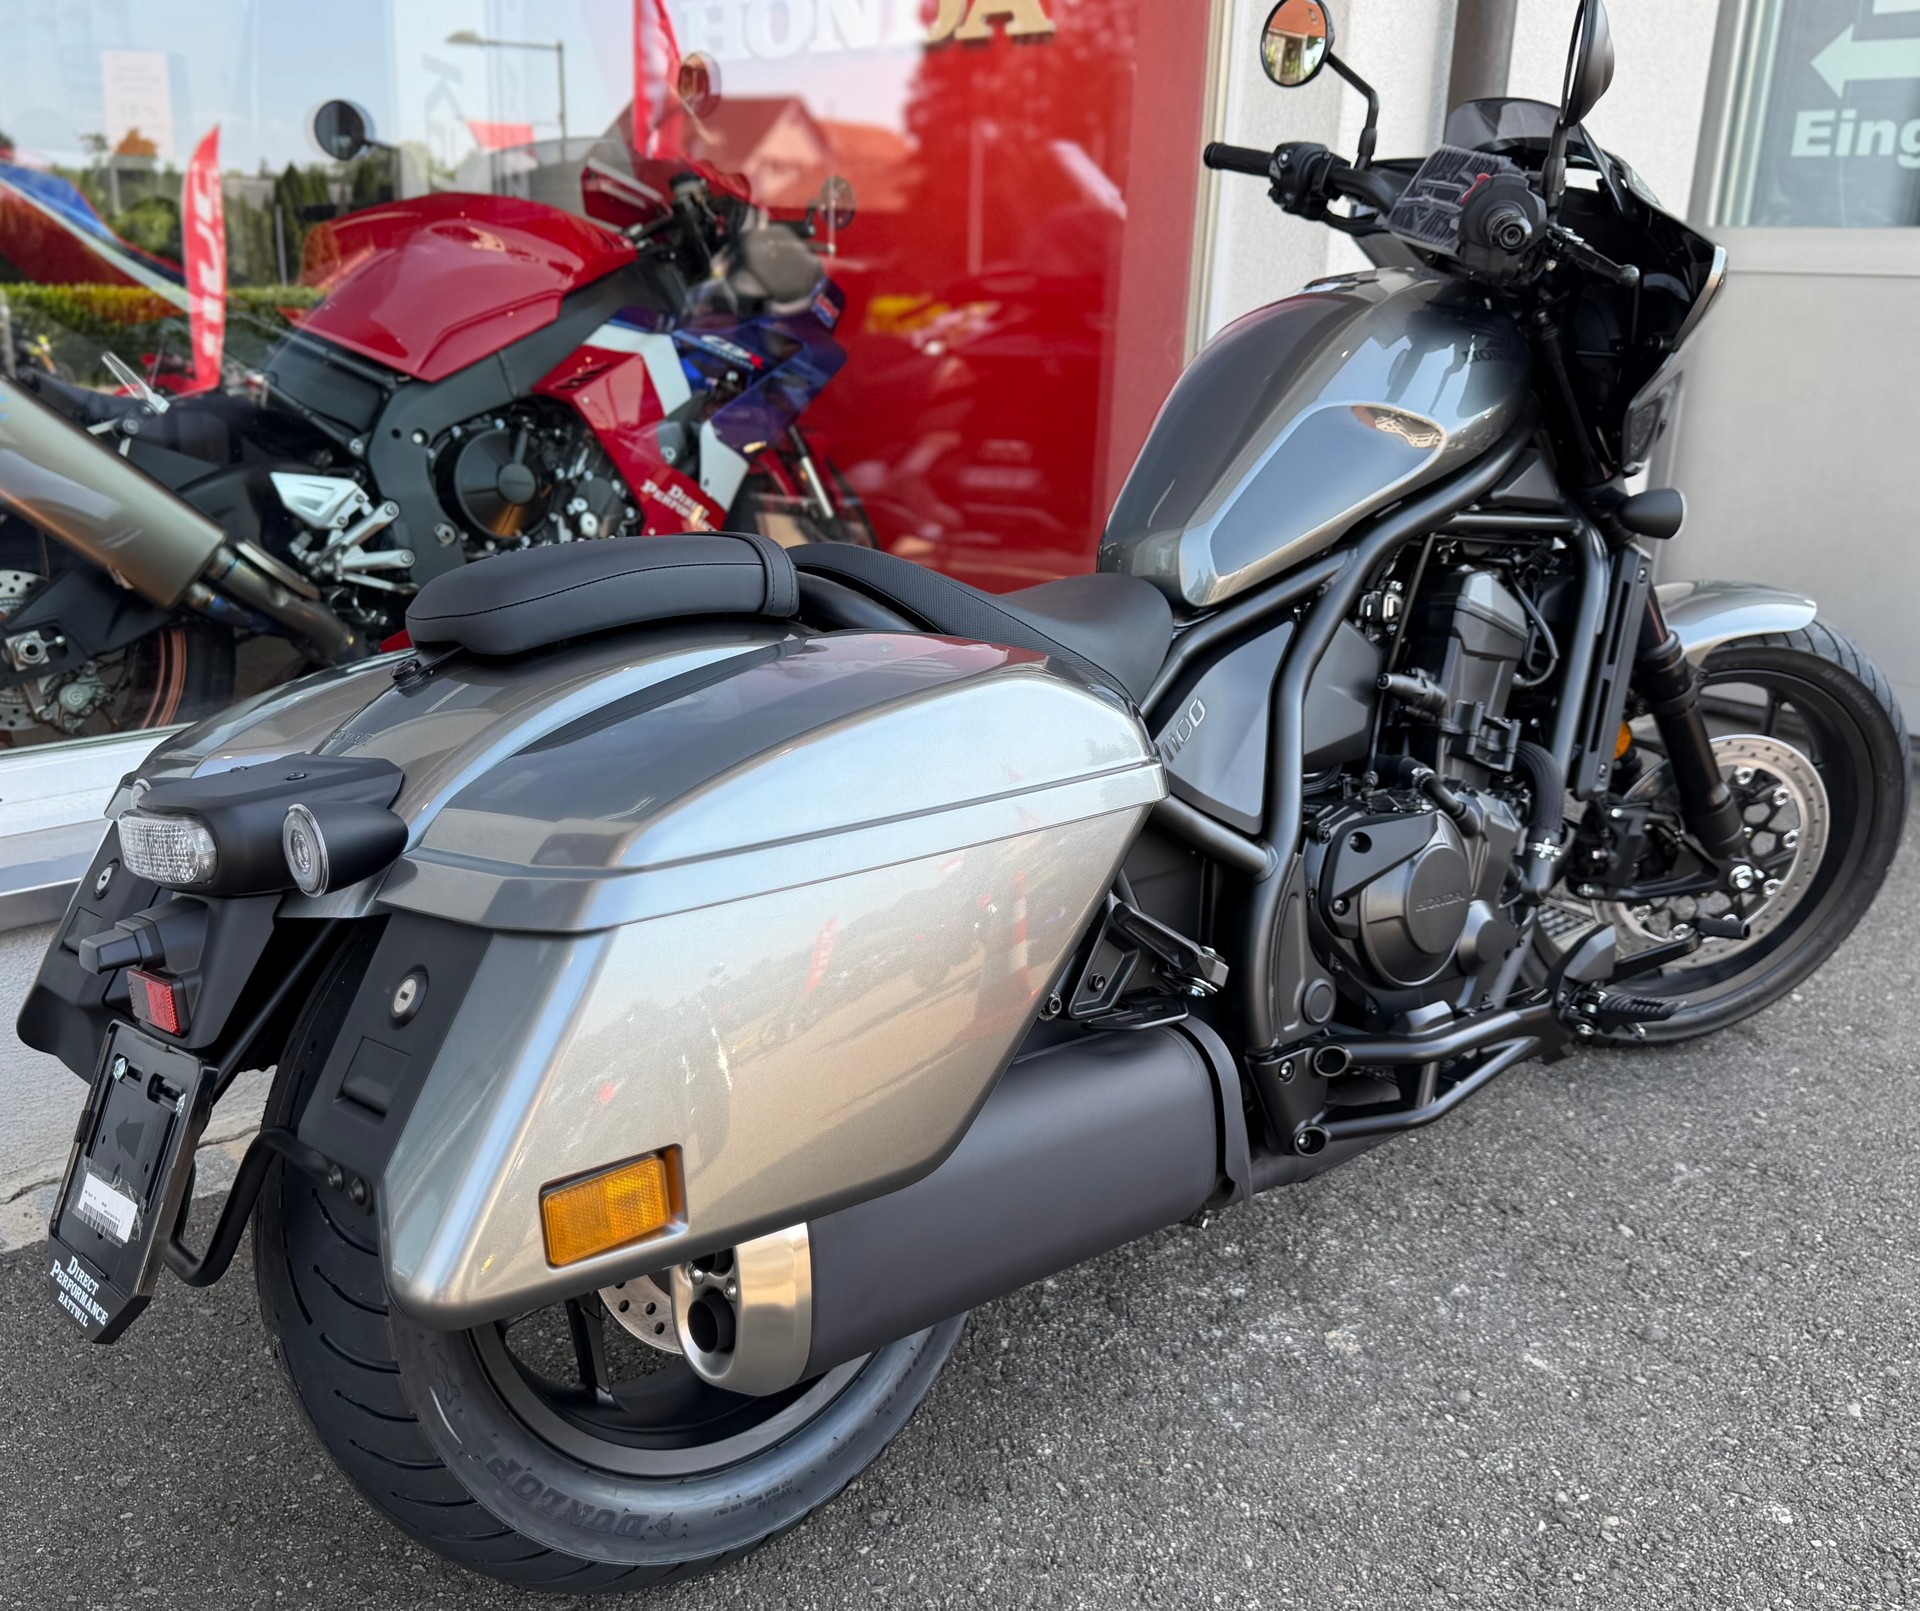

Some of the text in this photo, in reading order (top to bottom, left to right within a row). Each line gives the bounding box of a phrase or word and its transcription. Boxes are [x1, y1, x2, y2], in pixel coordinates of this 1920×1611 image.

[49, 1259, 109, 1326] PERFORMANCE
[66, 1255, 100, 1296] DIRECT
[485, 1456, 650, 1538] DUNLOP
